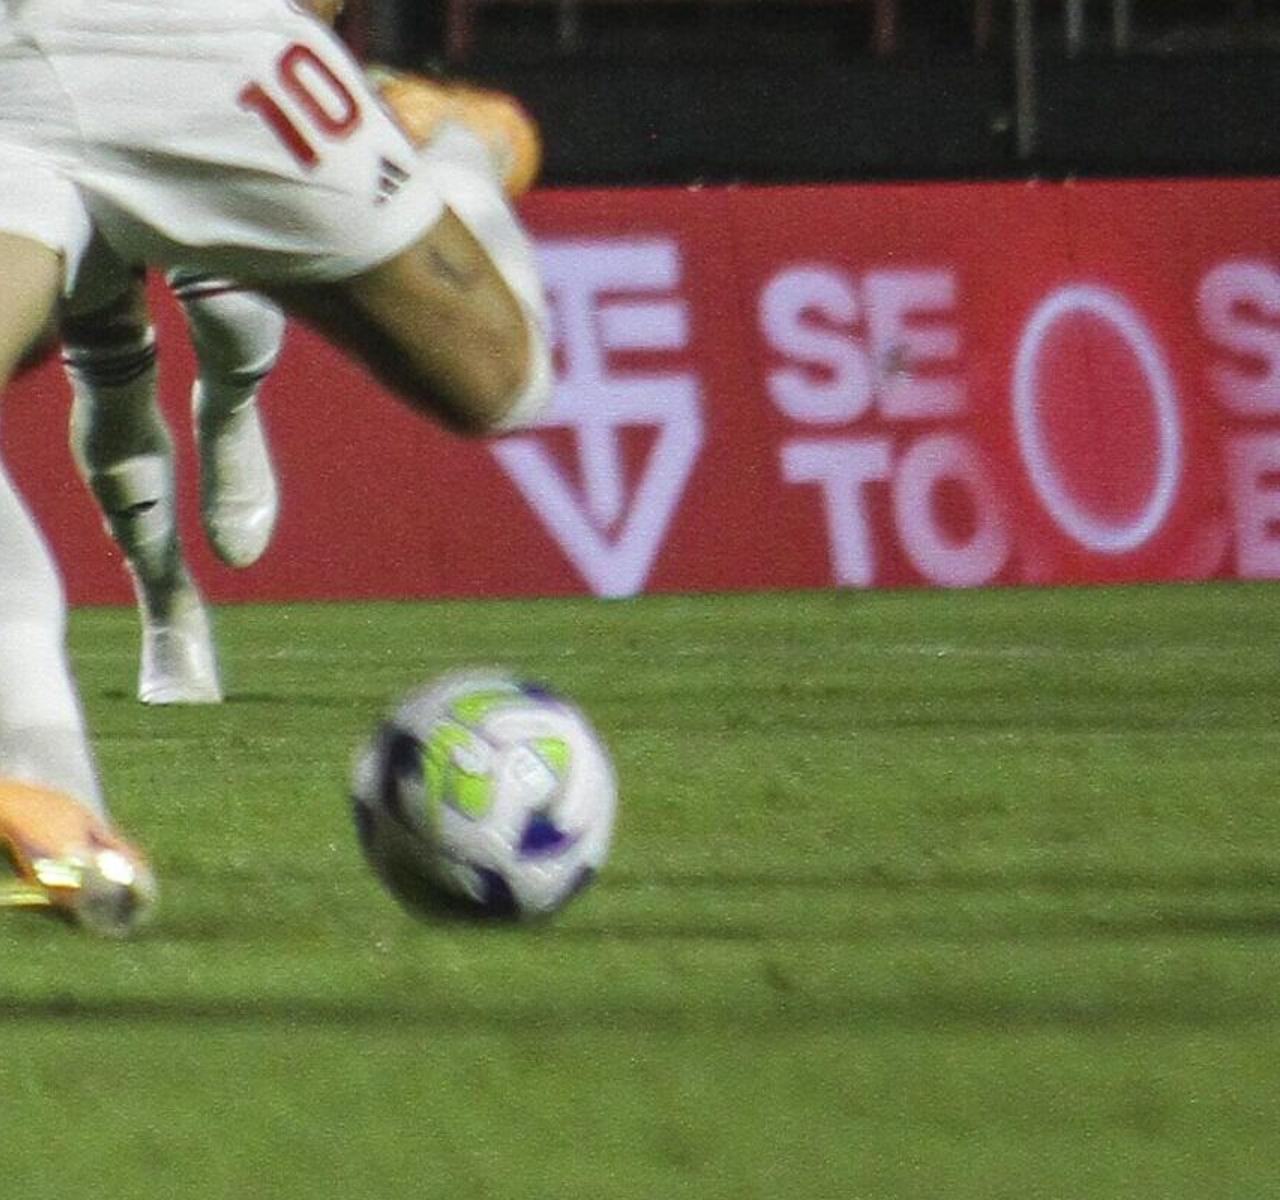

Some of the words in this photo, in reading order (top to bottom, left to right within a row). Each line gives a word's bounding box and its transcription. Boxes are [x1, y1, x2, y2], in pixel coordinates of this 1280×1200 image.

[237, 40, 363, 170] 10
[757, 262, 970, 425] SE
[778, 432, 1012, 590] TO
